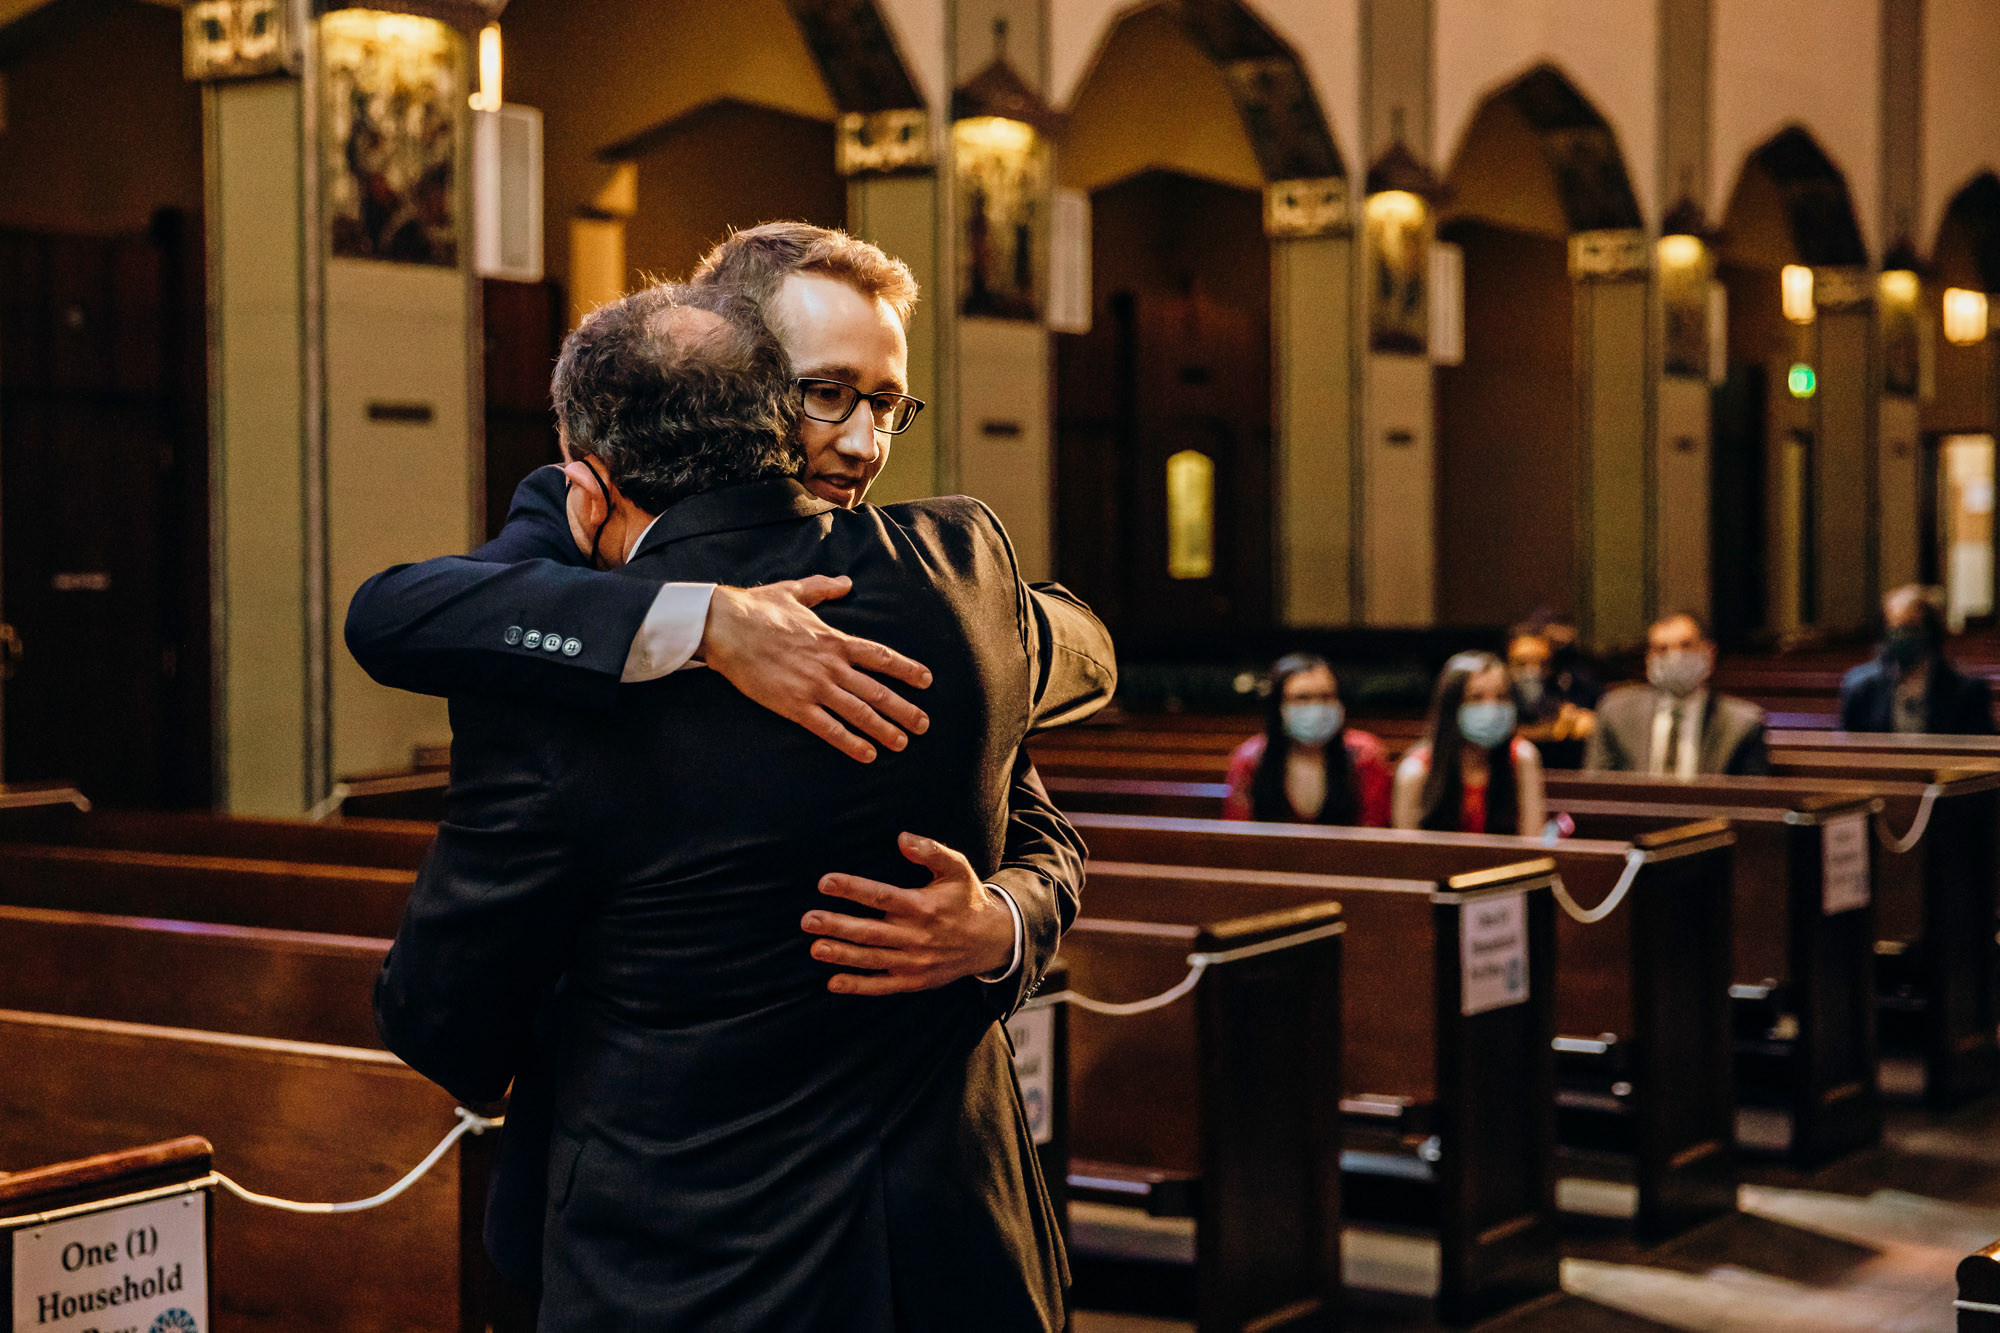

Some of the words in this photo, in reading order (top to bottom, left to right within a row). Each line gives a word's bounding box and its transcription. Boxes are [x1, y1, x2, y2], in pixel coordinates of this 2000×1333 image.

[62, 1241, 118, 1272] One
[127, 1225, 158, 1260] (1)
[37, 1263, 183, 1325] Household
